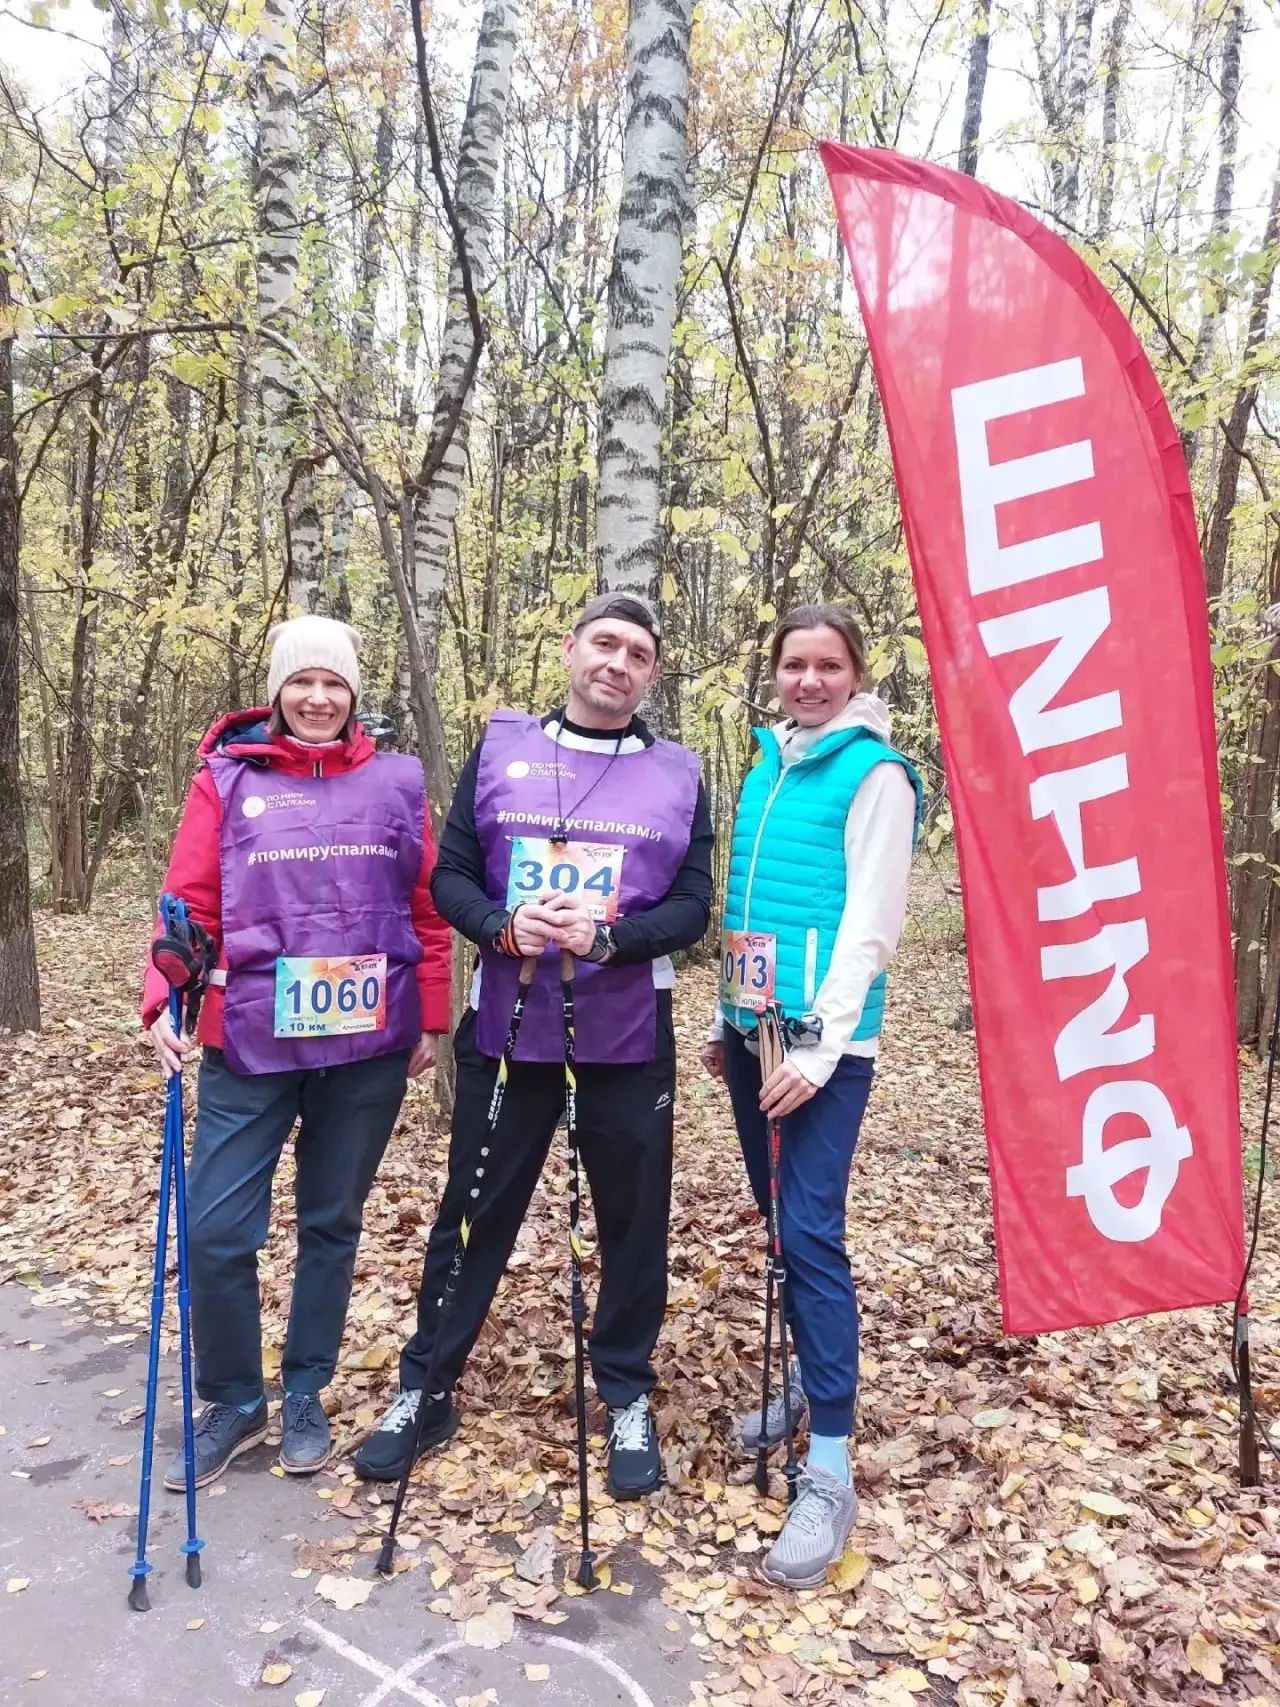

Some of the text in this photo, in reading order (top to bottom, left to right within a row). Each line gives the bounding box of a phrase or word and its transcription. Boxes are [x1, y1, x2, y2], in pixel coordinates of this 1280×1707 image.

[266, 792, 304, 802] ПО МИРУ
[275, 799, 317, 808] ПАЛКАМИ
[951, 356, 1194, 1243] ФИНИШ
[247, 844, 399, 867] #помируспалками
[514, 860, 615, 897] 304
[286, 976, 380, 1015] 1060
[290, 1022, 305, 1032] 10
